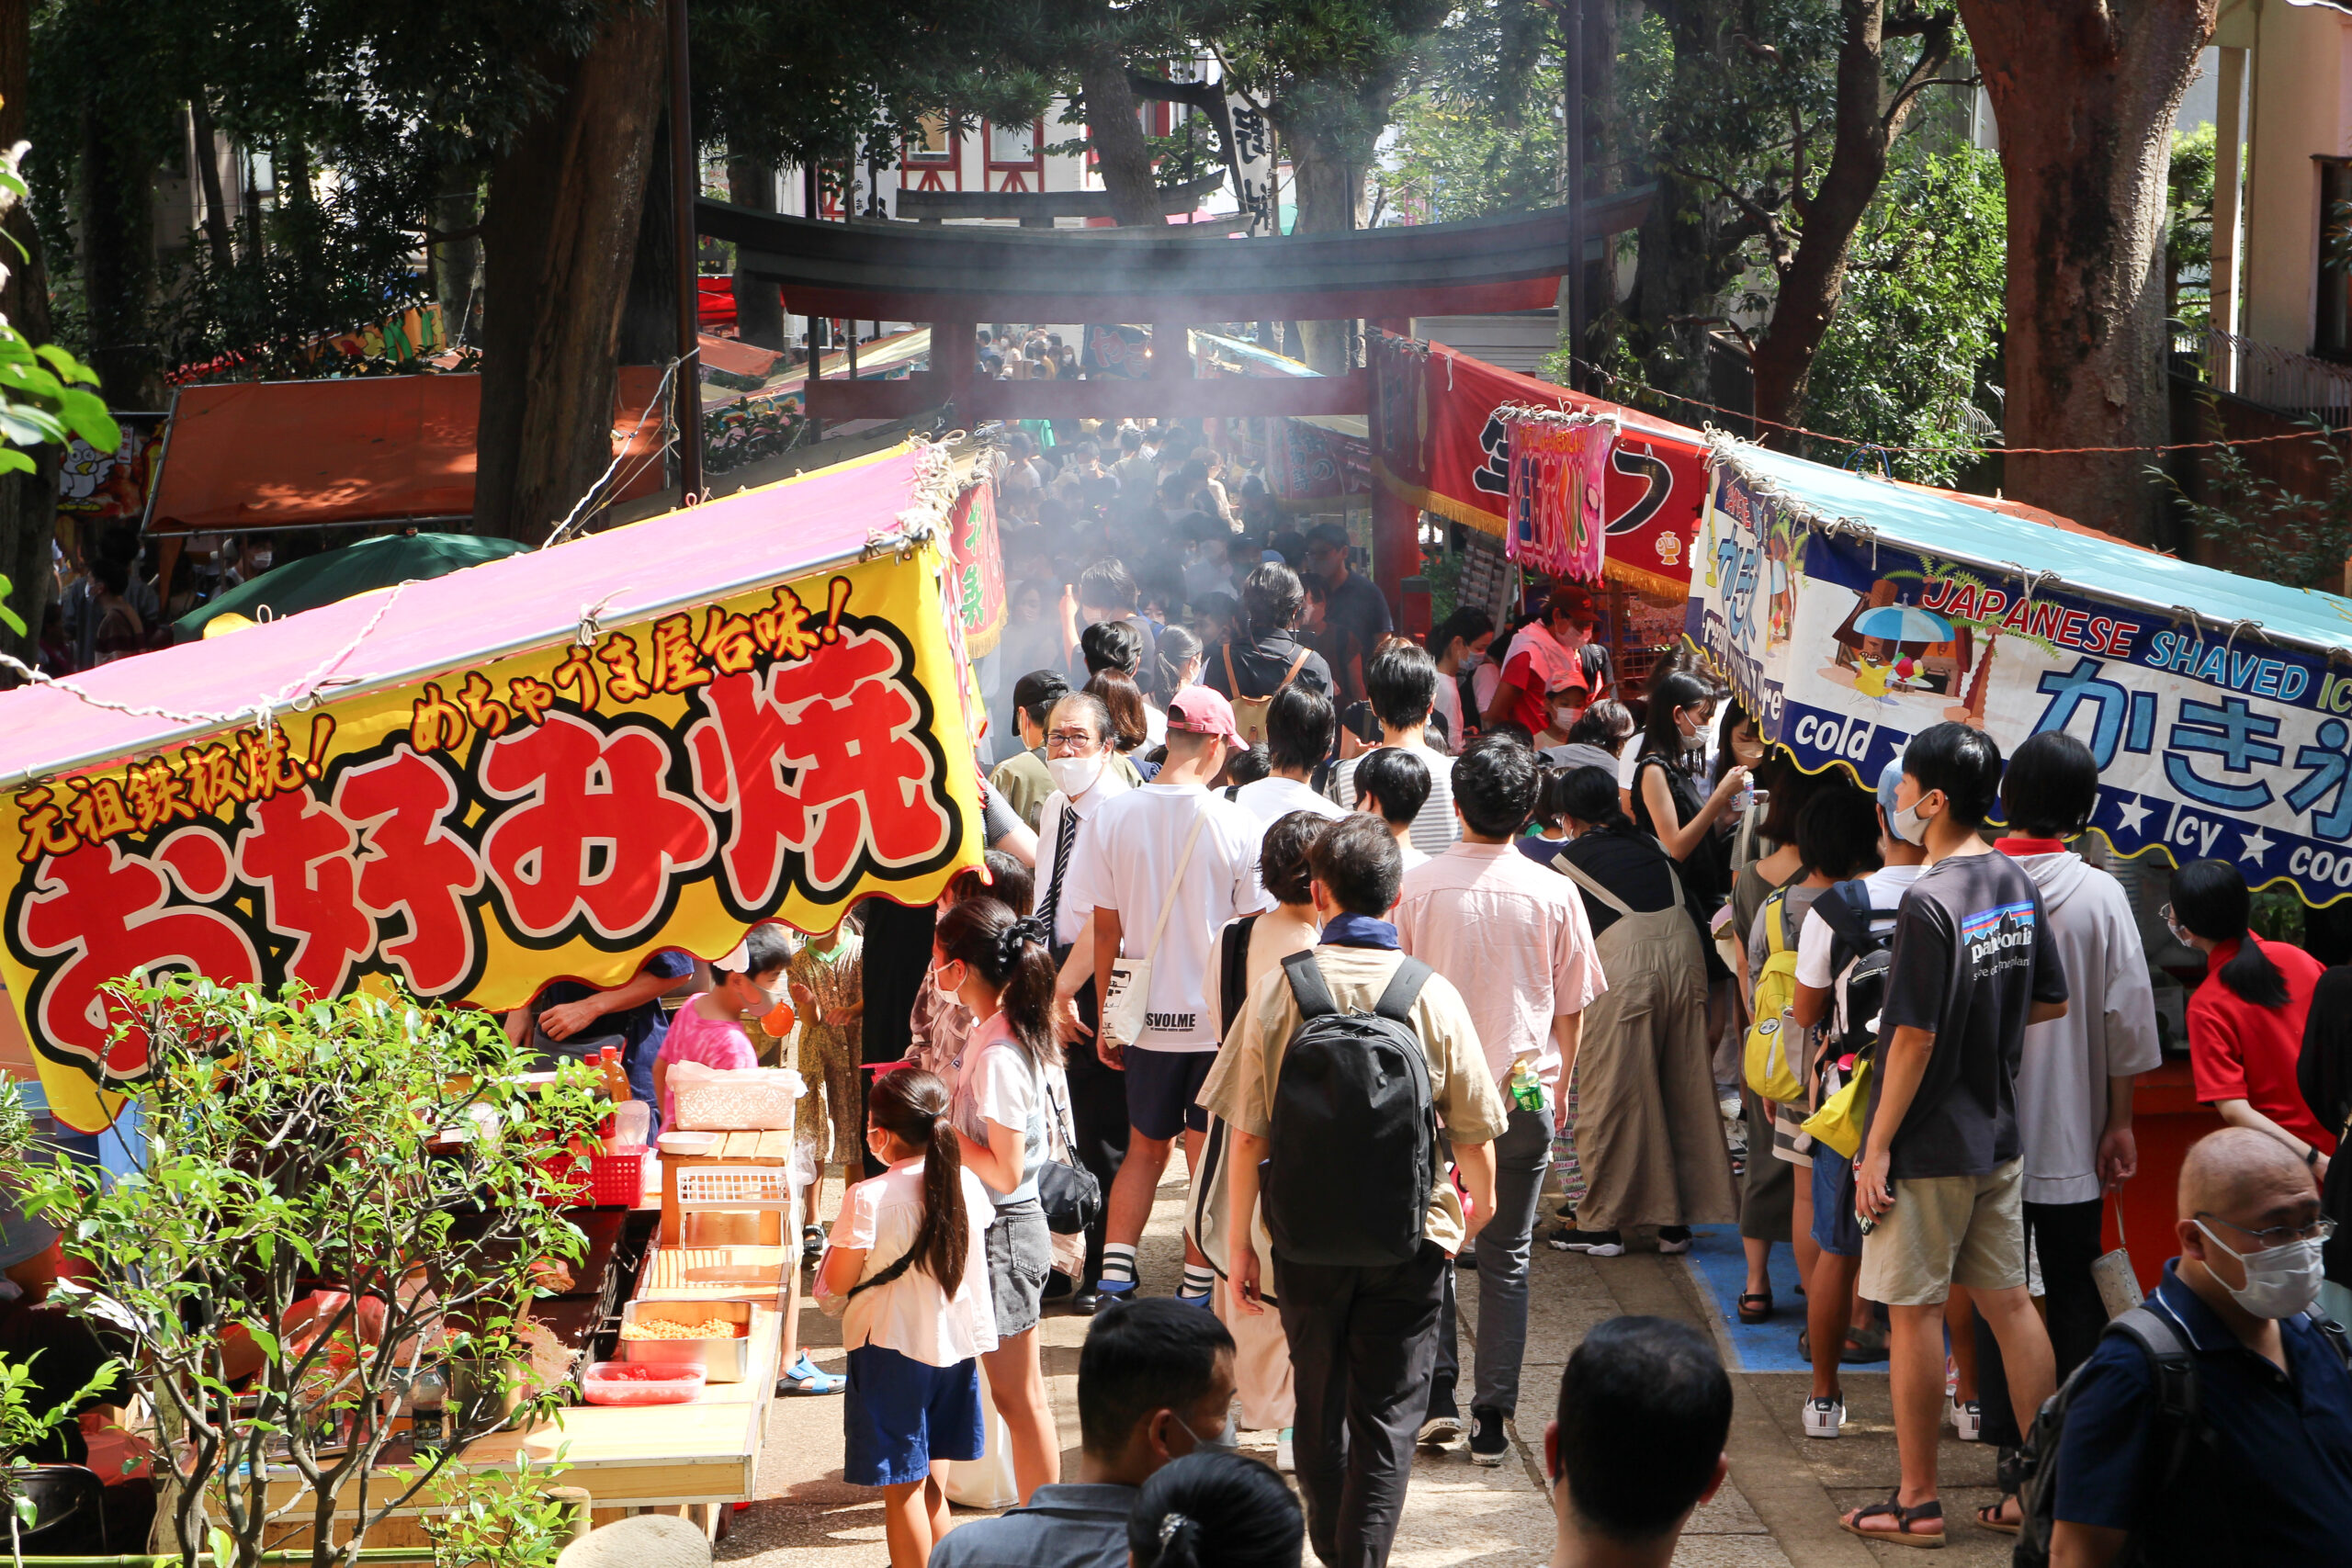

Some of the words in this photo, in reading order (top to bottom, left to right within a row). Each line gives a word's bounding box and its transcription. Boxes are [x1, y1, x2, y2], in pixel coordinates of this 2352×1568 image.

[1922, 578, 2140, 659] JAPANESE
[2145, 630, 2310, 701] SHAVED
[2316, 671, 2352, 715] IC
[1794, 715, 1877, 762] cold
[7, 621, 961, 1082] お好み焼
[2163, 802, 2224, 858] Icy
[2289, 845, 2352, 888] coo
[1146, 1012, 1196, 1028] SVOLME
